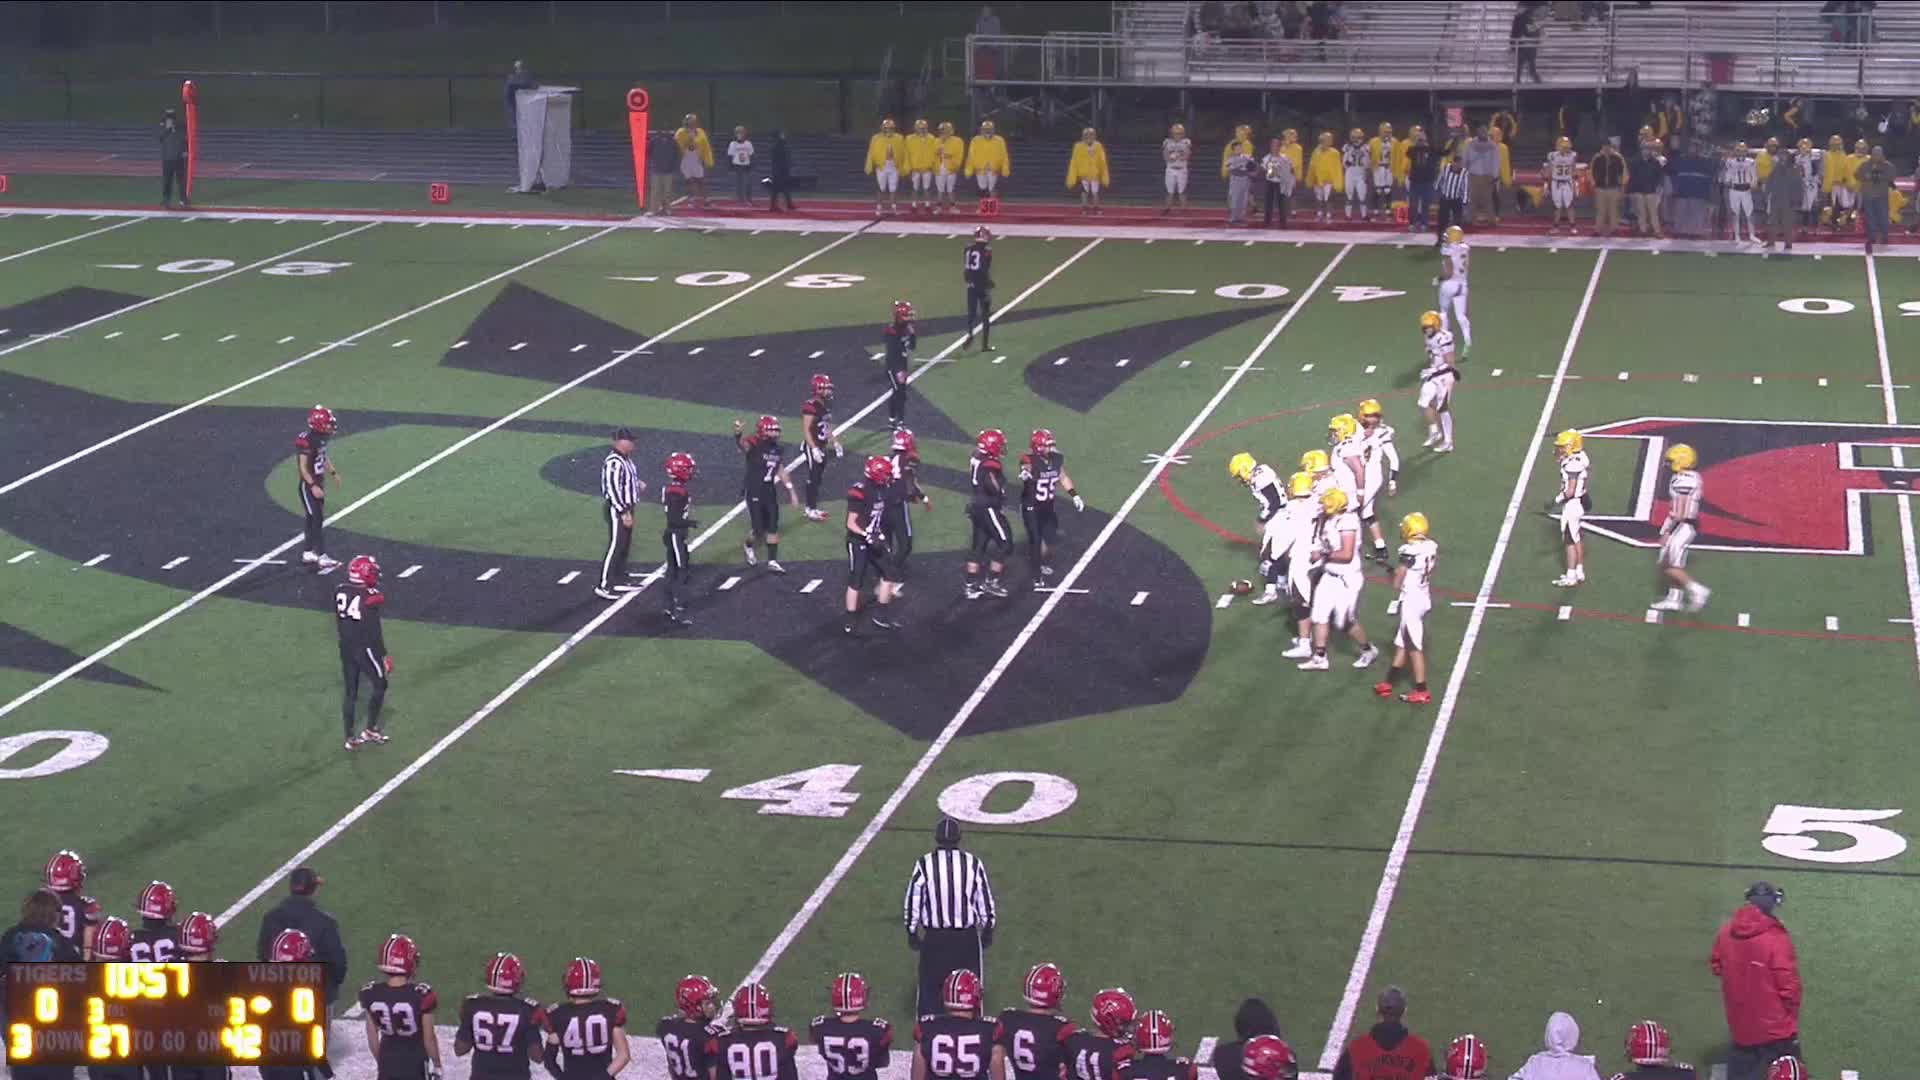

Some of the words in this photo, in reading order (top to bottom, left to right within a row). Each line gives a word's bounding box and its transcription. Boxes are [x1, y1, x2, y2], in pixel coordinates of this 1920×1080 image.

[965, 250, 980, 270] 13
[763, 461, 776, 482] 7
[336, 593, 361, 620] 24
[1761, 804, 1907, 863] 5
[370, 1001, 417, 1036] 33
[472, 1011, 520, 1053] 67
[563, 1014, 609, 1055] 40
[663, 1033, 698, 1078] 61
[727, 1041, 778, 1080] 80
[823, 1036, 869, 1075] 53
[931, 1034, 981, 1078] 65
[1013, 1029, 1037, 1072] 6
